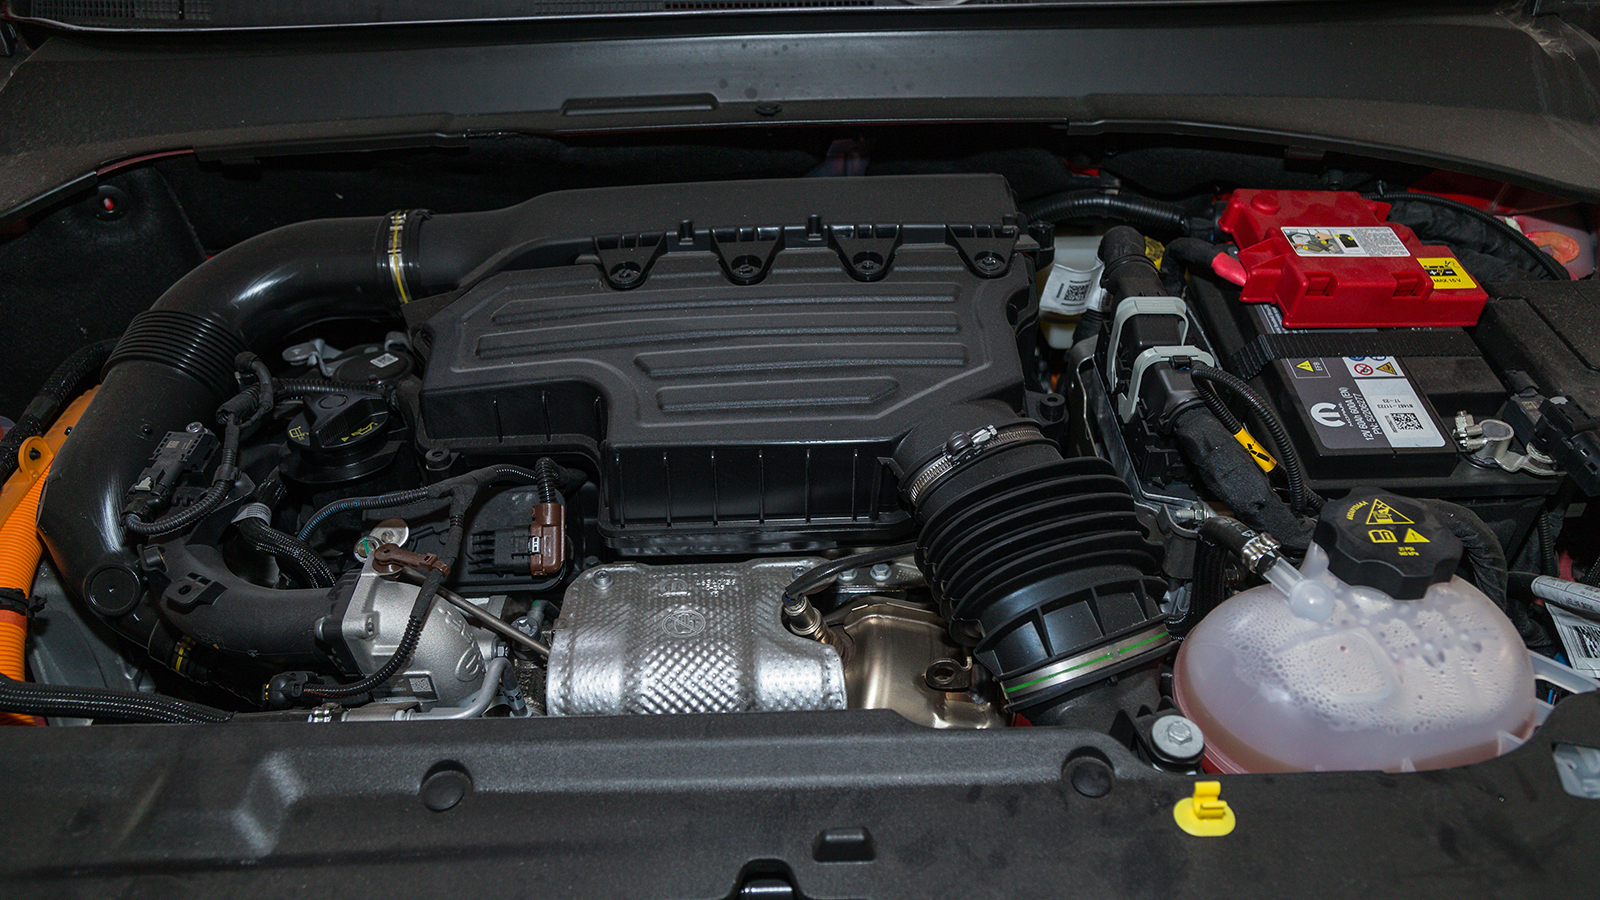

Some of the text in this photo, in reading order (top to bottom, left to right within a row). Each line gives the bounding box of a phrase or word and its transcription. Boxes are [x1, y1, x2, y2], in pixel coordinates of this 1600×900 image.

[1338, 386, 1374, 441] 12V 60Ah 600A (EN)
